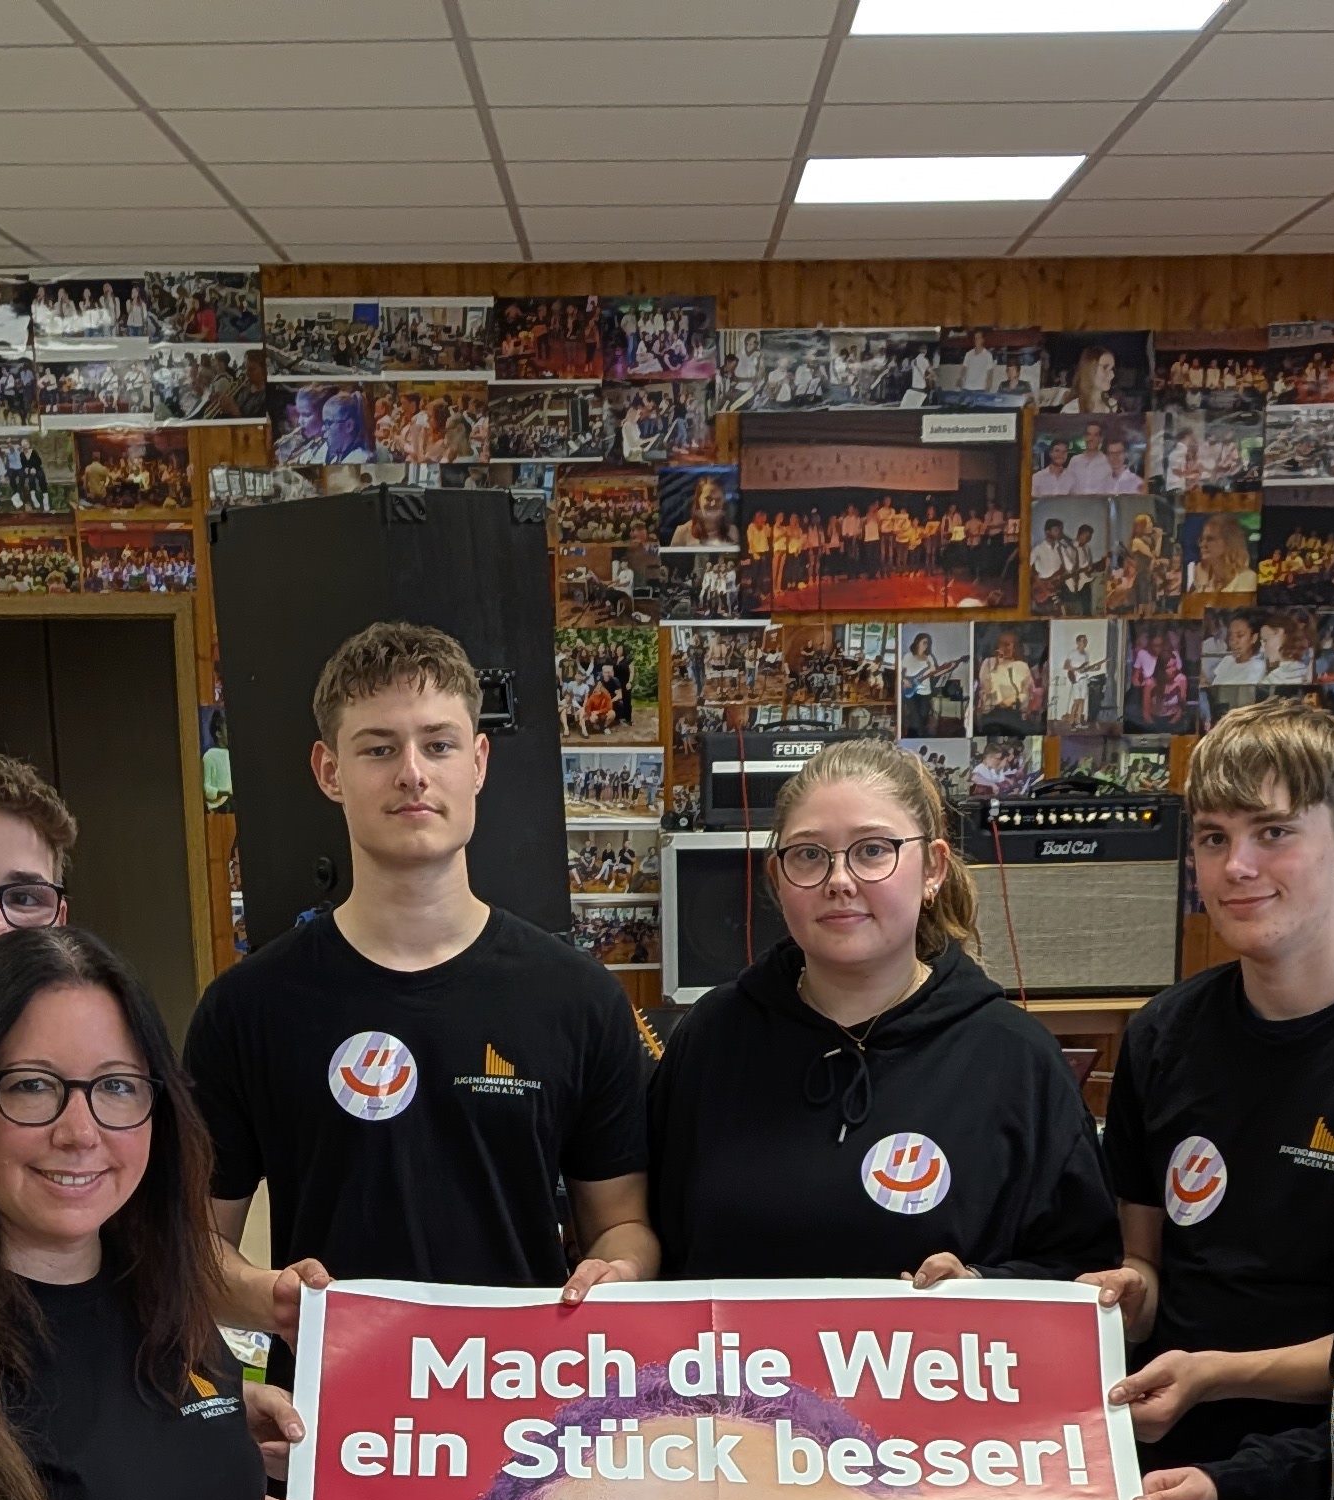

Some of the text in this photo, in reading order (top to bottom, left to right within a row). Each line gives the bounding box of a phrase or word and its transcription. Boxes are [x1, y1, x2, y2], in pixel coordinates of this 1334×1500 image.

[775, 743, 822, 755] FENDER
[1040, 840, 1099, 856] Bad Cat
[471, 1084, 501, 1094] HAGEN
[410, 1331, 1020, 1403] Mach die Welt
[340, 1417, 1090, 1487] ein Stück besser!
